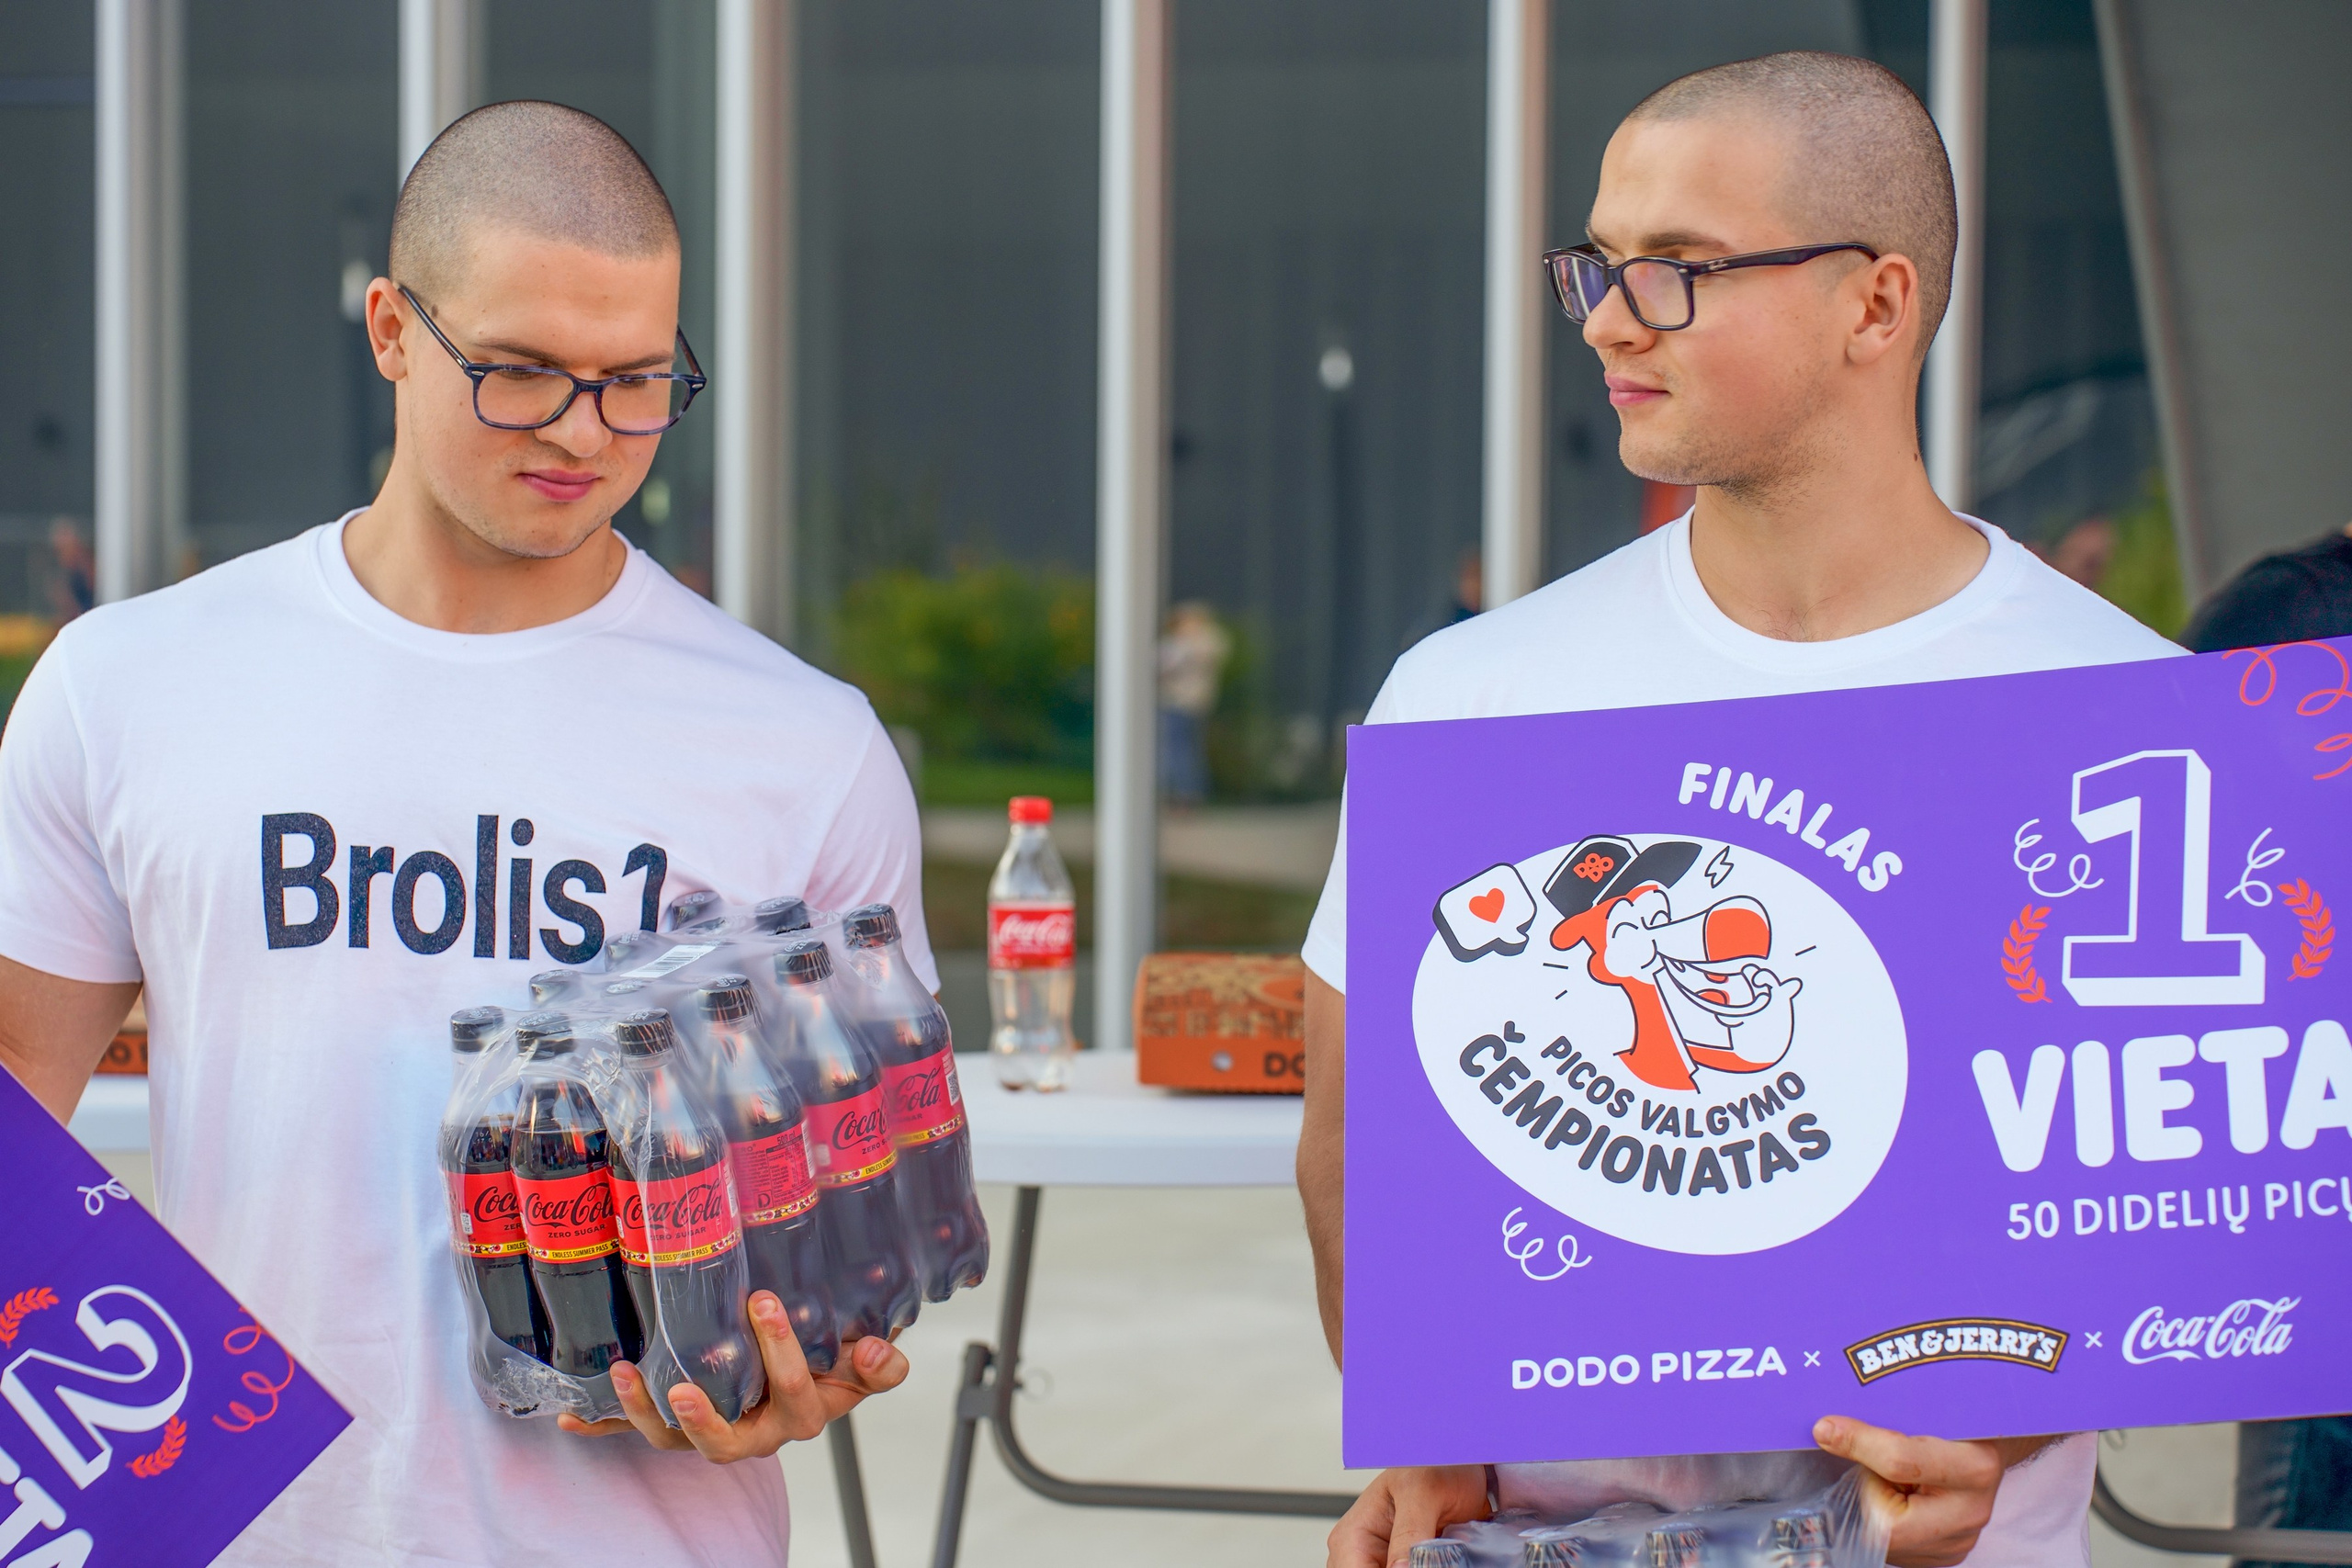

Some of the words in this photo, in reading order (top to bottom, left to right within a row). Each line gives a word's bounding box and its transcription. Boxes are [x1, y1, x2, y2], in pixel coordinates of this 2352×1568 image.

[1678, 761, 1903, 893] FINALAS
[2062, 748, 2267, 1007] 1
[1459, 1021, 1832, 1197] ČEMPIONATAS
[1541, 1035, 1635, 1119] PICOS
[1640, 1071, 1806, 1138] VALGYMO
[1972, 1019, 2352, 1173] VIETA
[504, 1223, 522, 1231] ZER
[548, 1230, 571, 1239] ZERO
[574, 1224, 606, 1237] SUGAR
[552, 1248, 573, 1258] ENDLESS
[573, 1245, 595, 1258] SUMMER
[595, 1243, 609, 1253] PASS
[651, 1252, 673, 1262] NDLESS
[695, 1246, 708, 1257] PASS
[675, 1226, 707, 1239] SUGAR
[2007, 1200, 2061, 1241] 50
[2073, 1184, 2251, 1235] DIDELIŲ
[1, 1284, 193, 1490] 2
[1511, 1353, 1641, 1391] DODO
[1651, 1345, 1788, 1384] PIZZA
[2121, 1295, 2302, 1365] Coca-Cola
